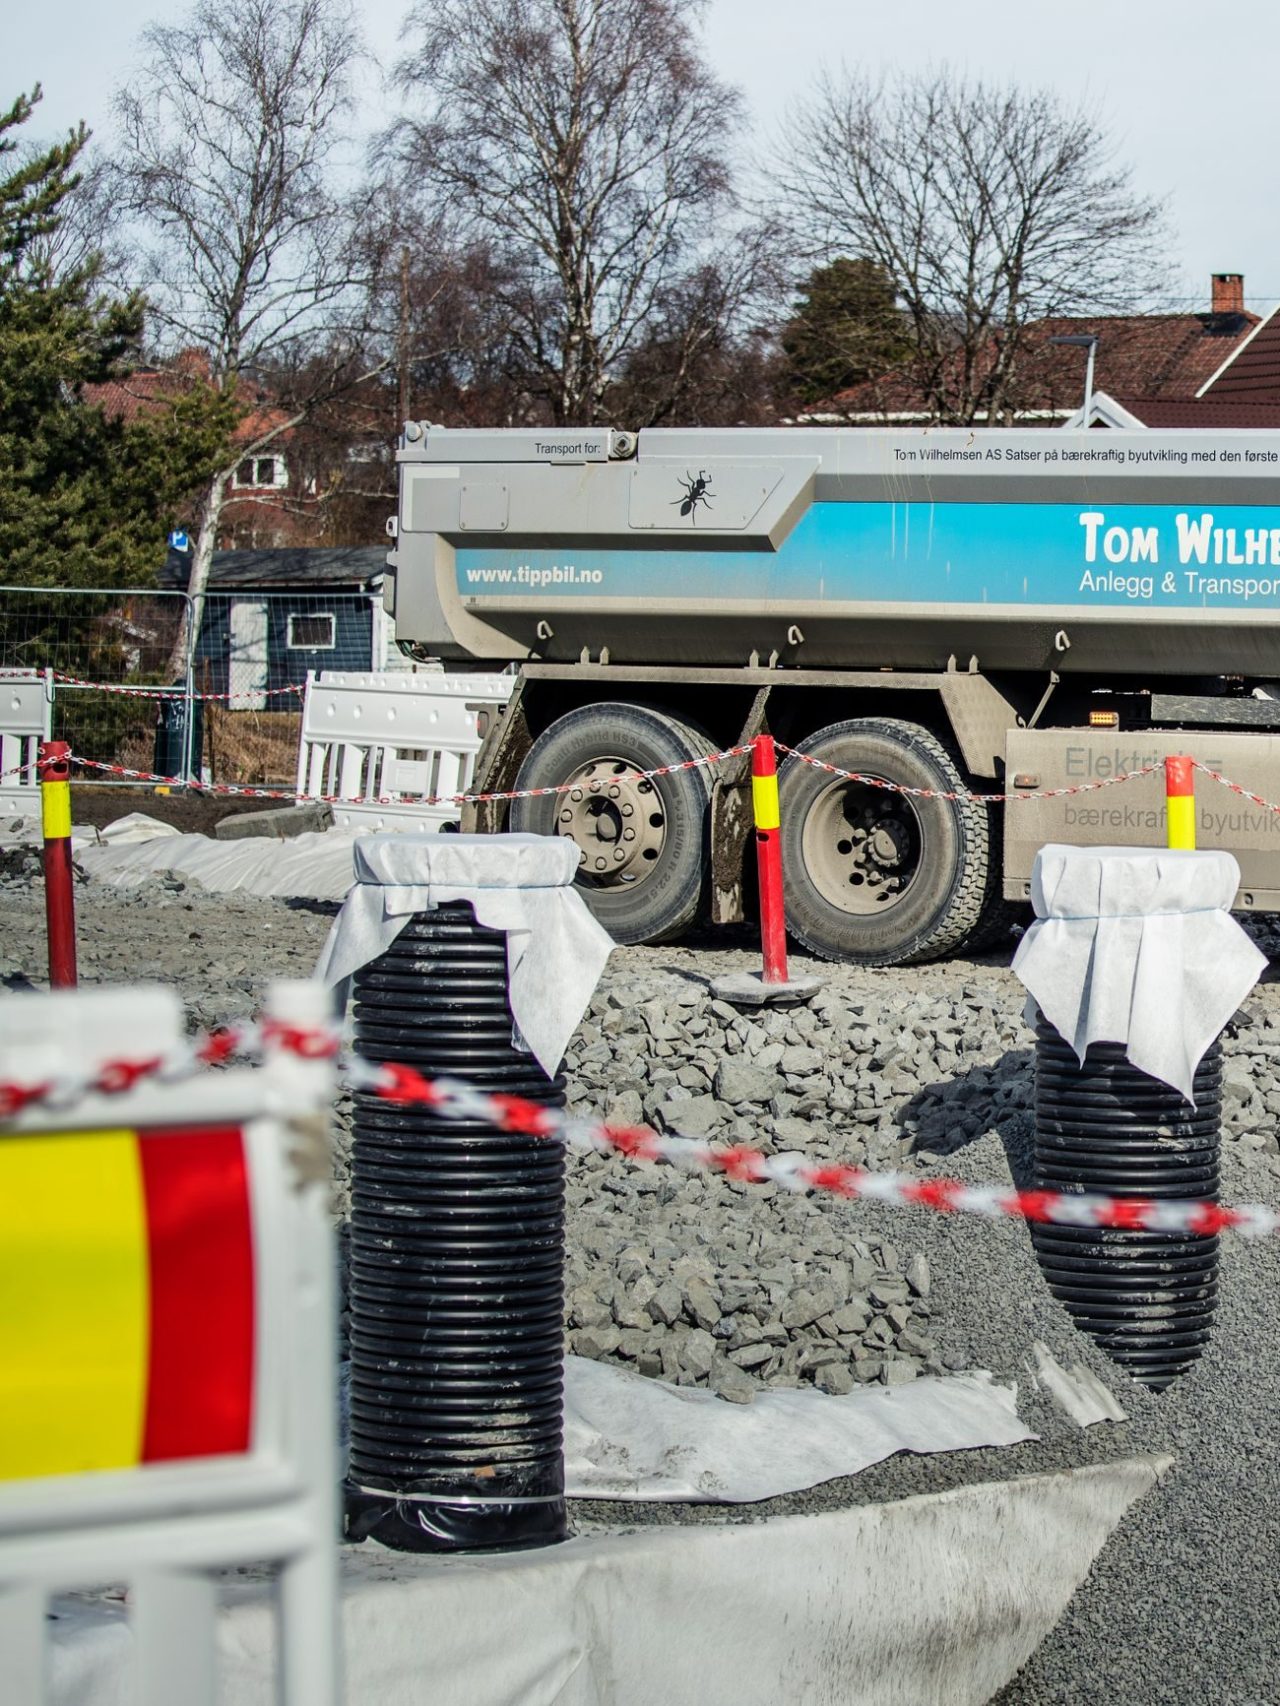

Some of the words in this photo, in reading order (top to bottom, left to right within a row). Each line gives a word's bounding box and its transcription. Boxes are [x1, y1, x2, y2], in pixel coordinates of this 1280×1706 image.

[535, 443, 582, 456] Transport
[584, 443, 601, 454] for:
[894, 449, 917, 461] Tom
[919, 449, 982, 461] Wilhelmsen
[985, 449, 1002, 461] AS
[1005, 449, 1040, 461] Satser
[1044, 448, 1058, 463] på
[1061, 448, 1125, 464] bærekraftig
[1128, 449, 1188, 464] byutvikling
[1191, 450, 1217, 463] med
[1219, 450, 1242, 463] den
[1244, 450, 1278, 463] første
[172, 531, 184, 545] P
[1079, 512, 1159, 564] TOM
[466, 566, 603, 588] www.tippbil.no
[1079, 571, 1154, 598] Anlegg
[1162, 572, 1177, 594] &
[1065, 746, 1183, 778] Elektri
[1064, 803, 1168, 829] bærekraf
